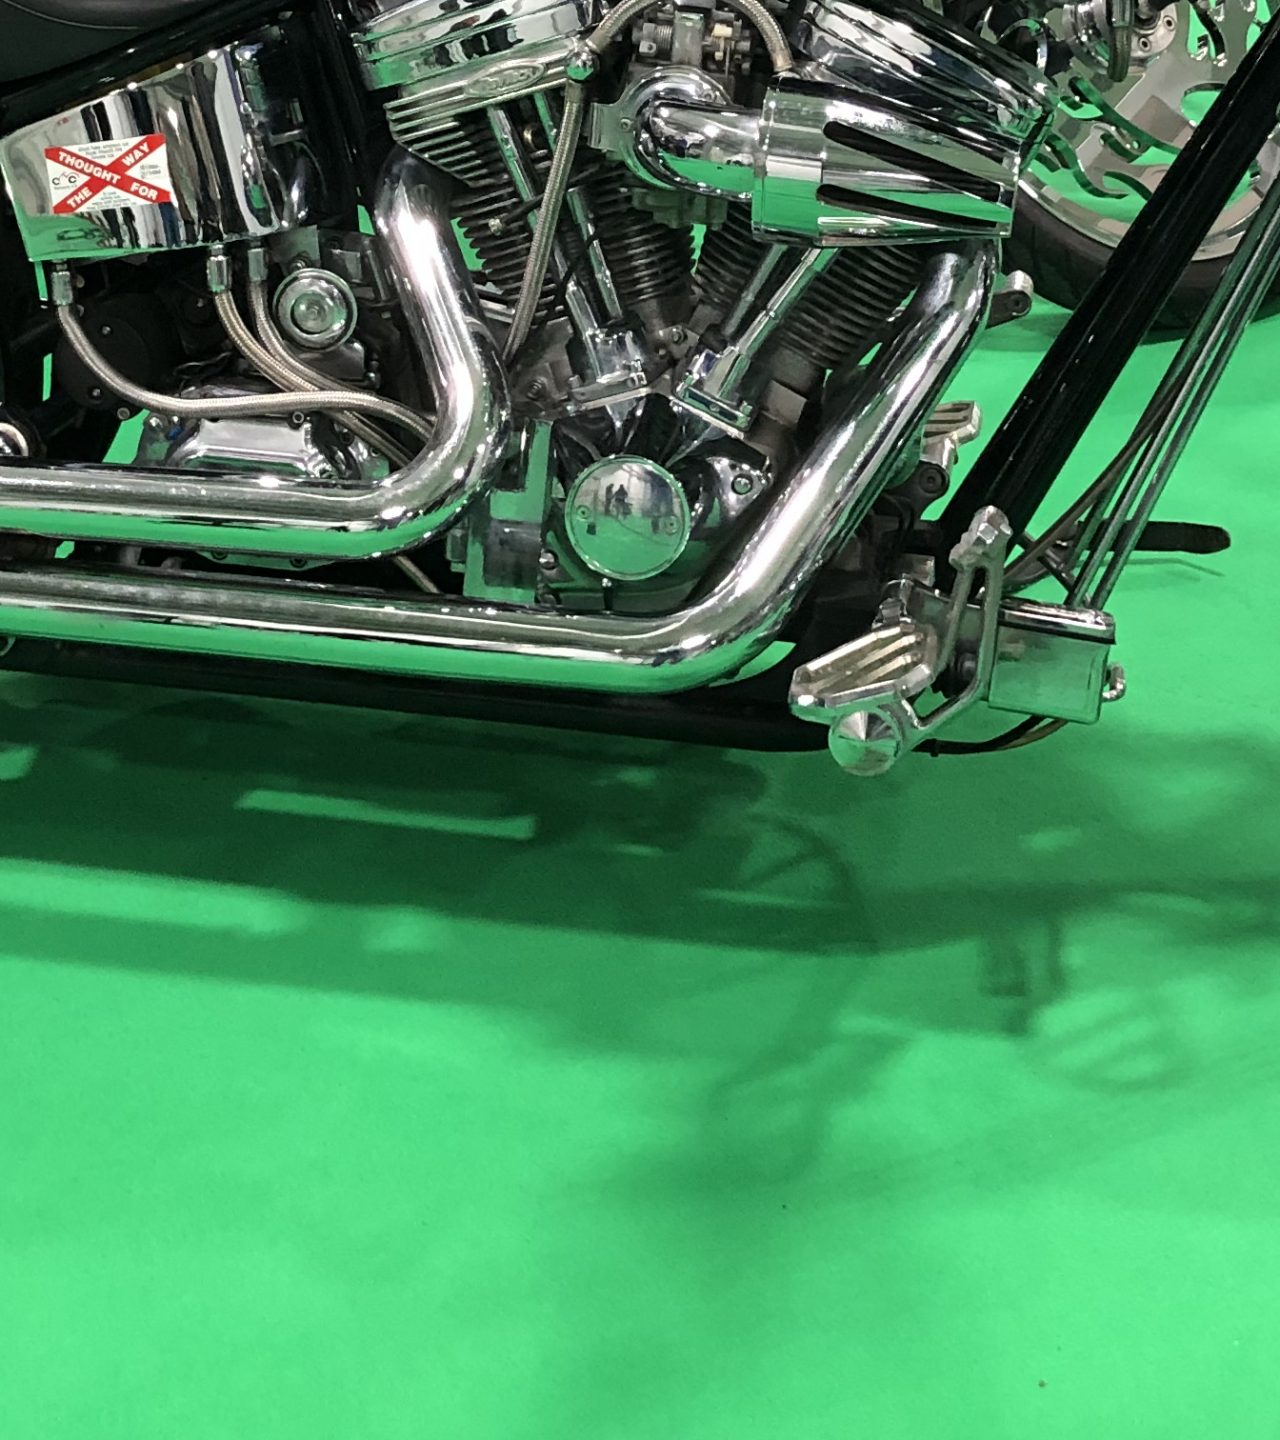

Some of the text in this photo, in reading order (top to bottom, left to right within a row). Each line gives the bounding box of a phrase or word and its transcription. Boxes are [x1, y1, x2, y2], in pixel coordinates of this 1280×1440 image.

[58, 151, 121, 184] THOUGHT
[129, 182, 159, 200] FOR
[66, 186, 93, 209] THE
[121, 141, 150, 167] WAY
